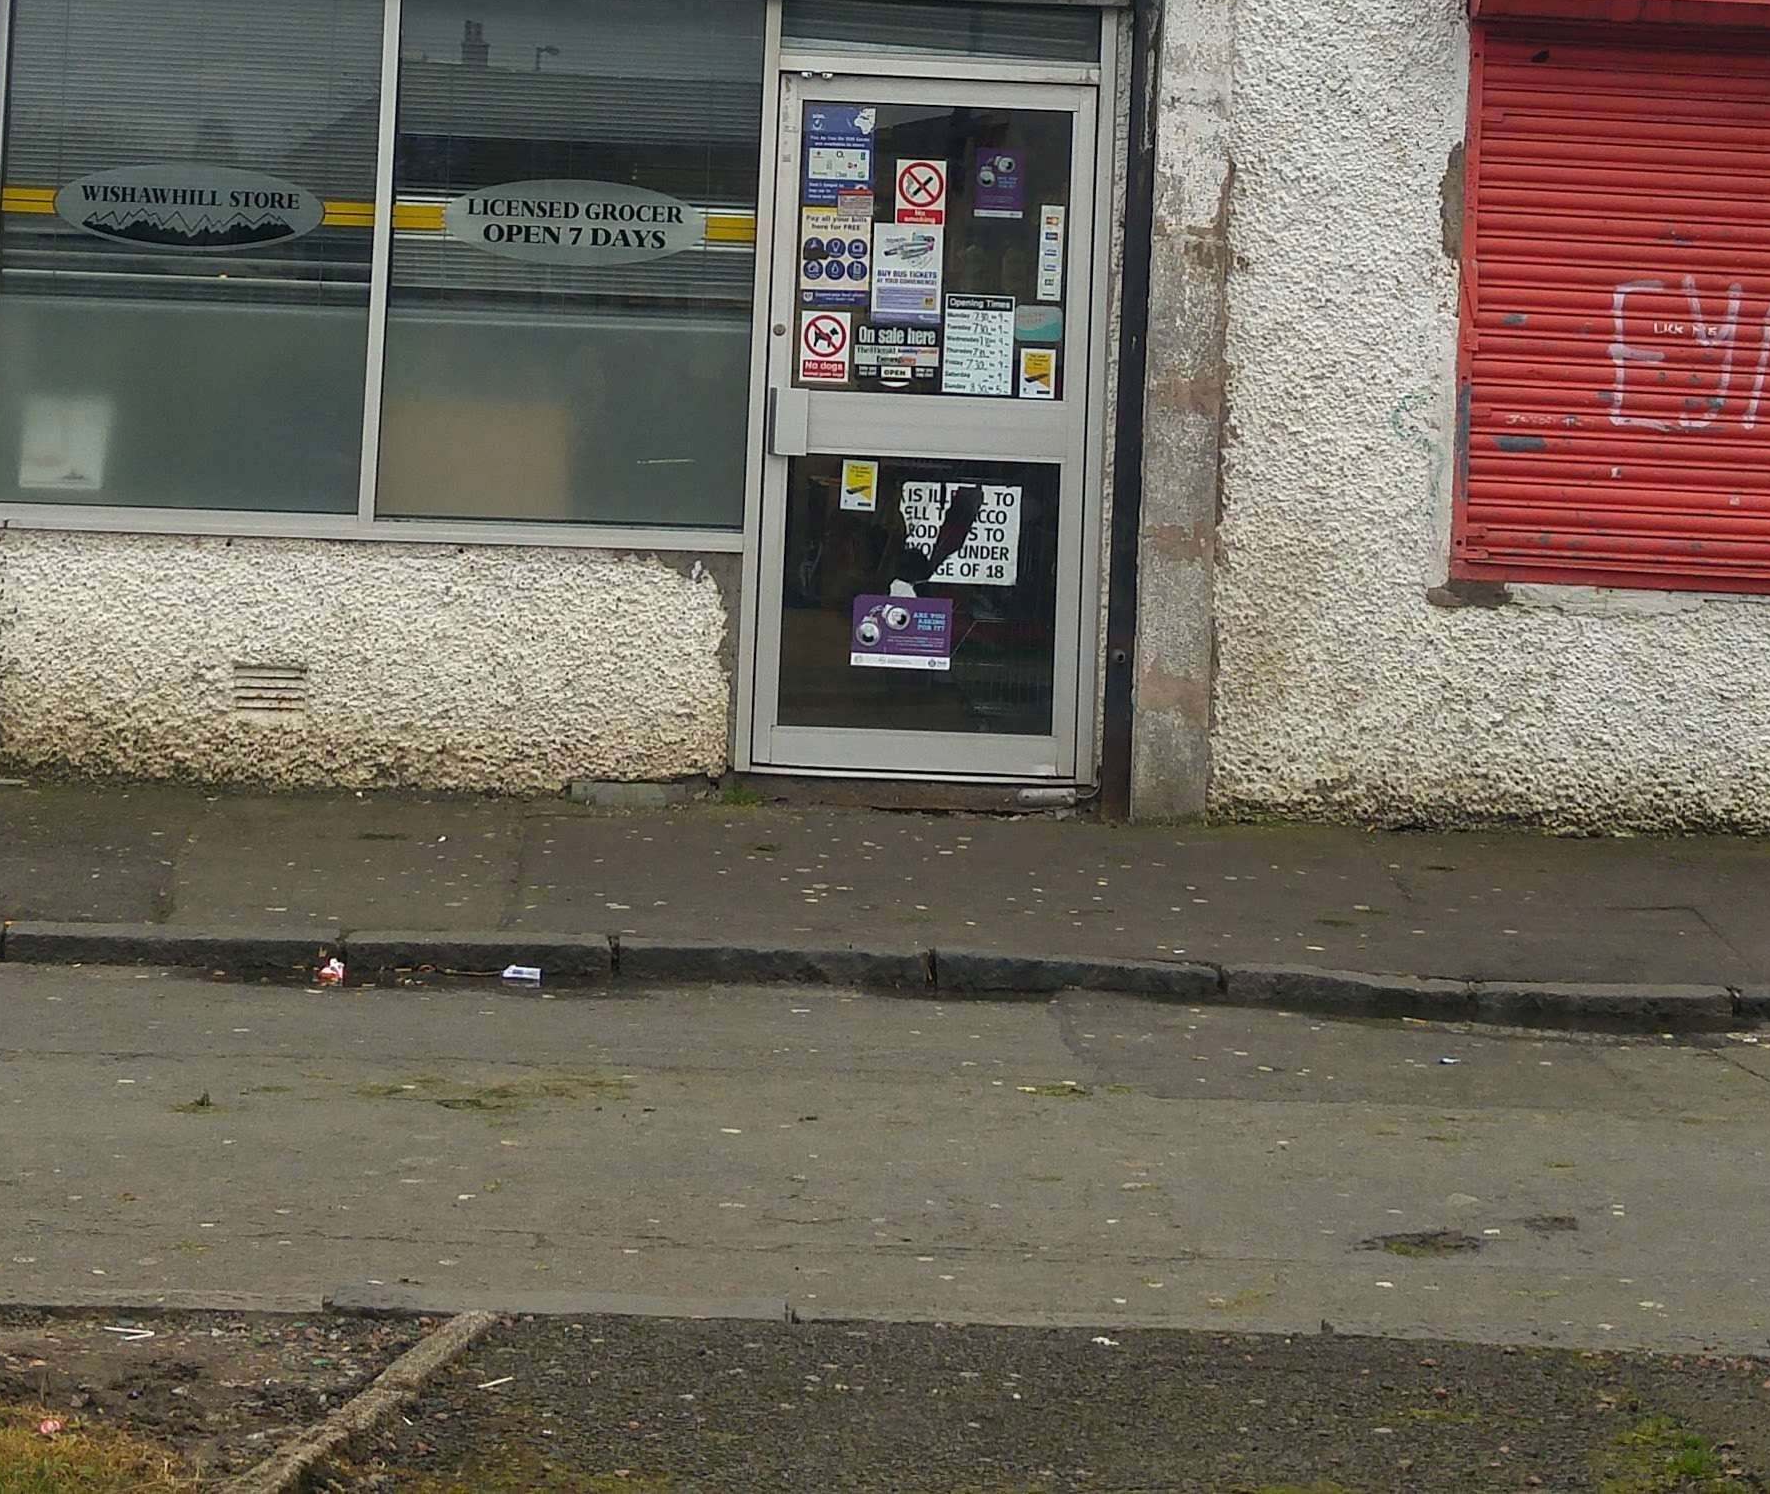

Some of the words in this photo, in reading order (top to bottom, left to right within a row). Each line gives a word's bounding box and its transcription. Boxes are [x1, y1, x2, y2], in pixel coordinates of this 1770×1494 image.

[81, 184, 222, 207] WISHAWHILL
[229, 190, 301, 210] STORE
[468, 198, 579, 220] LICENSED
[585, 203, 684, 224] GROCER
[482, 223, 562, 245] OPEN
[568, 226, 584, 246] 7
[590, 226, 666, 250] DAYS
[949, 297, 984, 309] Opening
[985, 299, 1011, 309] Times
[858, 326, 876, 344] On
[878, 326, 905, 345] sale
[907, 327, 936, 345] here
[804, 360, 819, 370] No
[820, 361, 844, 372] dogs
[908, 488, 923, 503] IS
[993, 491, 1015, 507] TO
[904, 505, 930, 521] ELL
[935, 506, 1007, 525] TCCO
[983, 527, 1005, 543] TO
[957, 544, 1010, 562] UNDER
[935, 562, 955, 577] GE
[959, 562, 981, 578] OF
[986, 564, 1004, 579] 18
